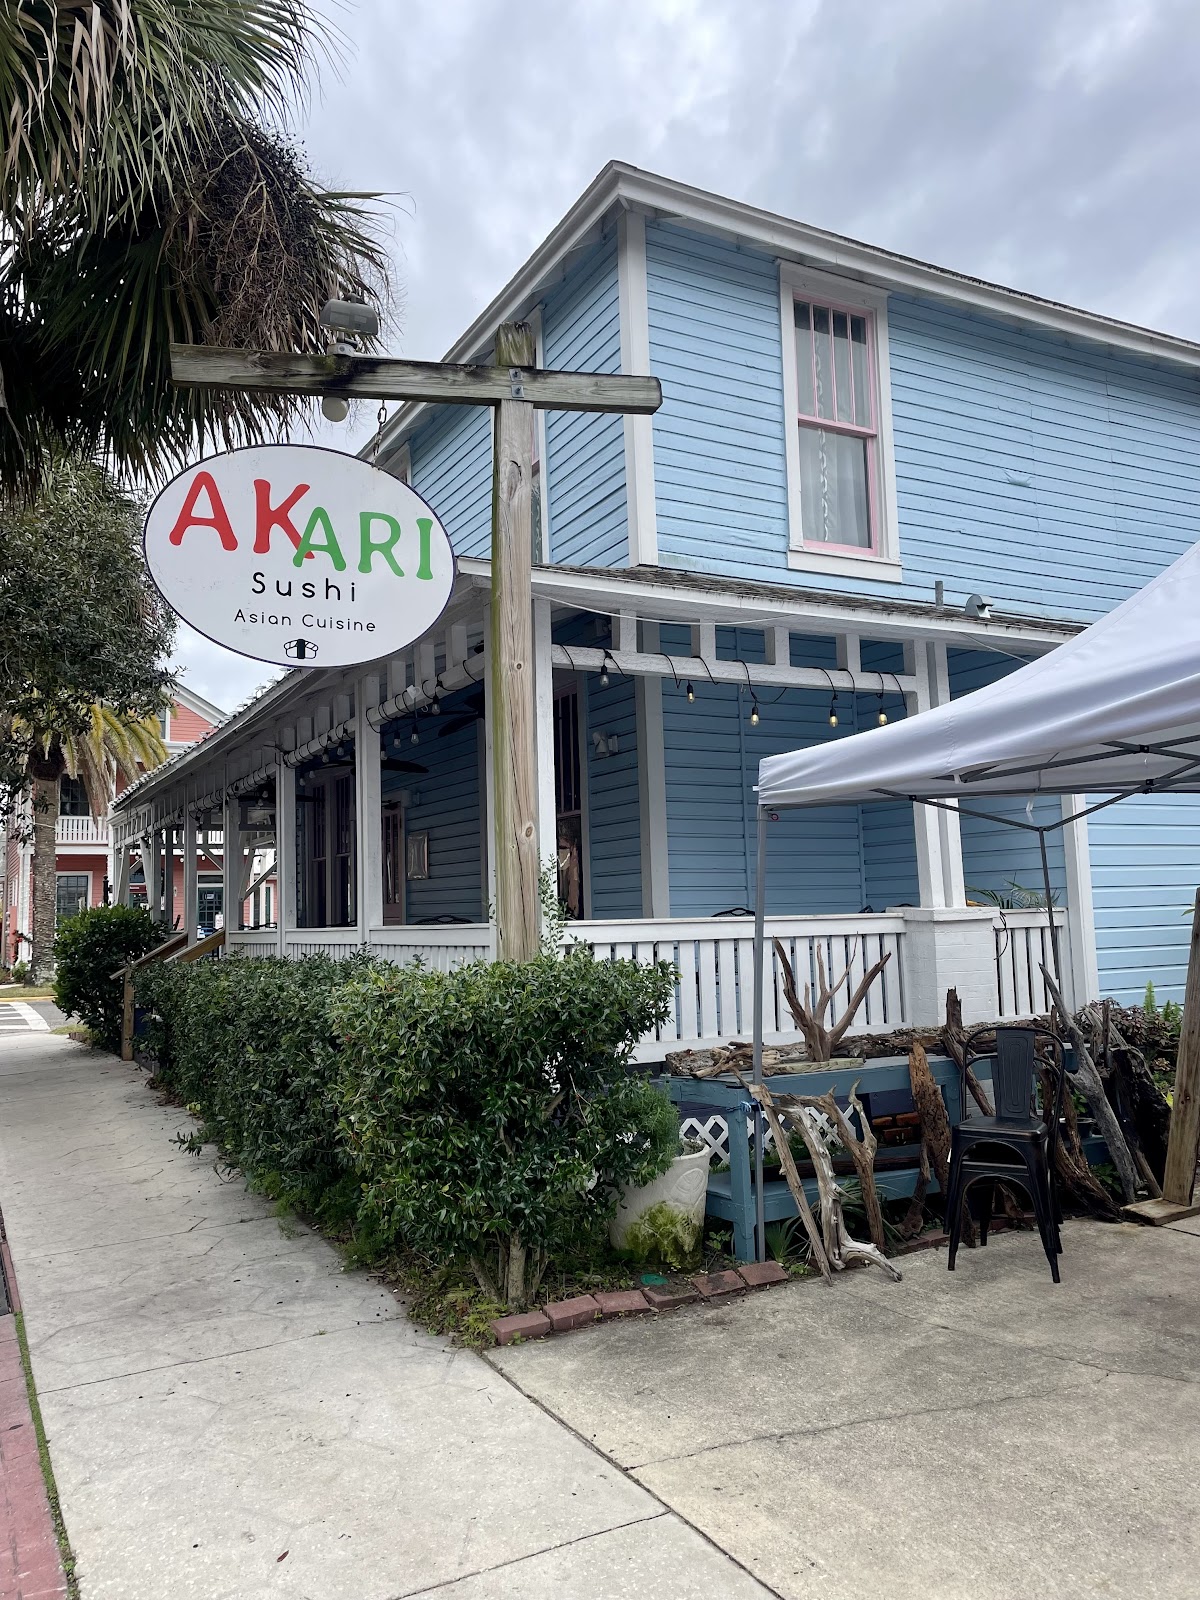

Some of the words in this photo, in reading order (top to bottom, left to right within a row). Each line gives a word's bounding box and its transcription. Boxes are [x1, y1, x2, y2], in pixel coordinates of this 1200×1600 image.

[169, 471, 434, 580] AKARI
[252, 571, 356, 602] Sushi
[233, 608, 292, 627] Asian
[301, 613, 376, 632] Cuisine
